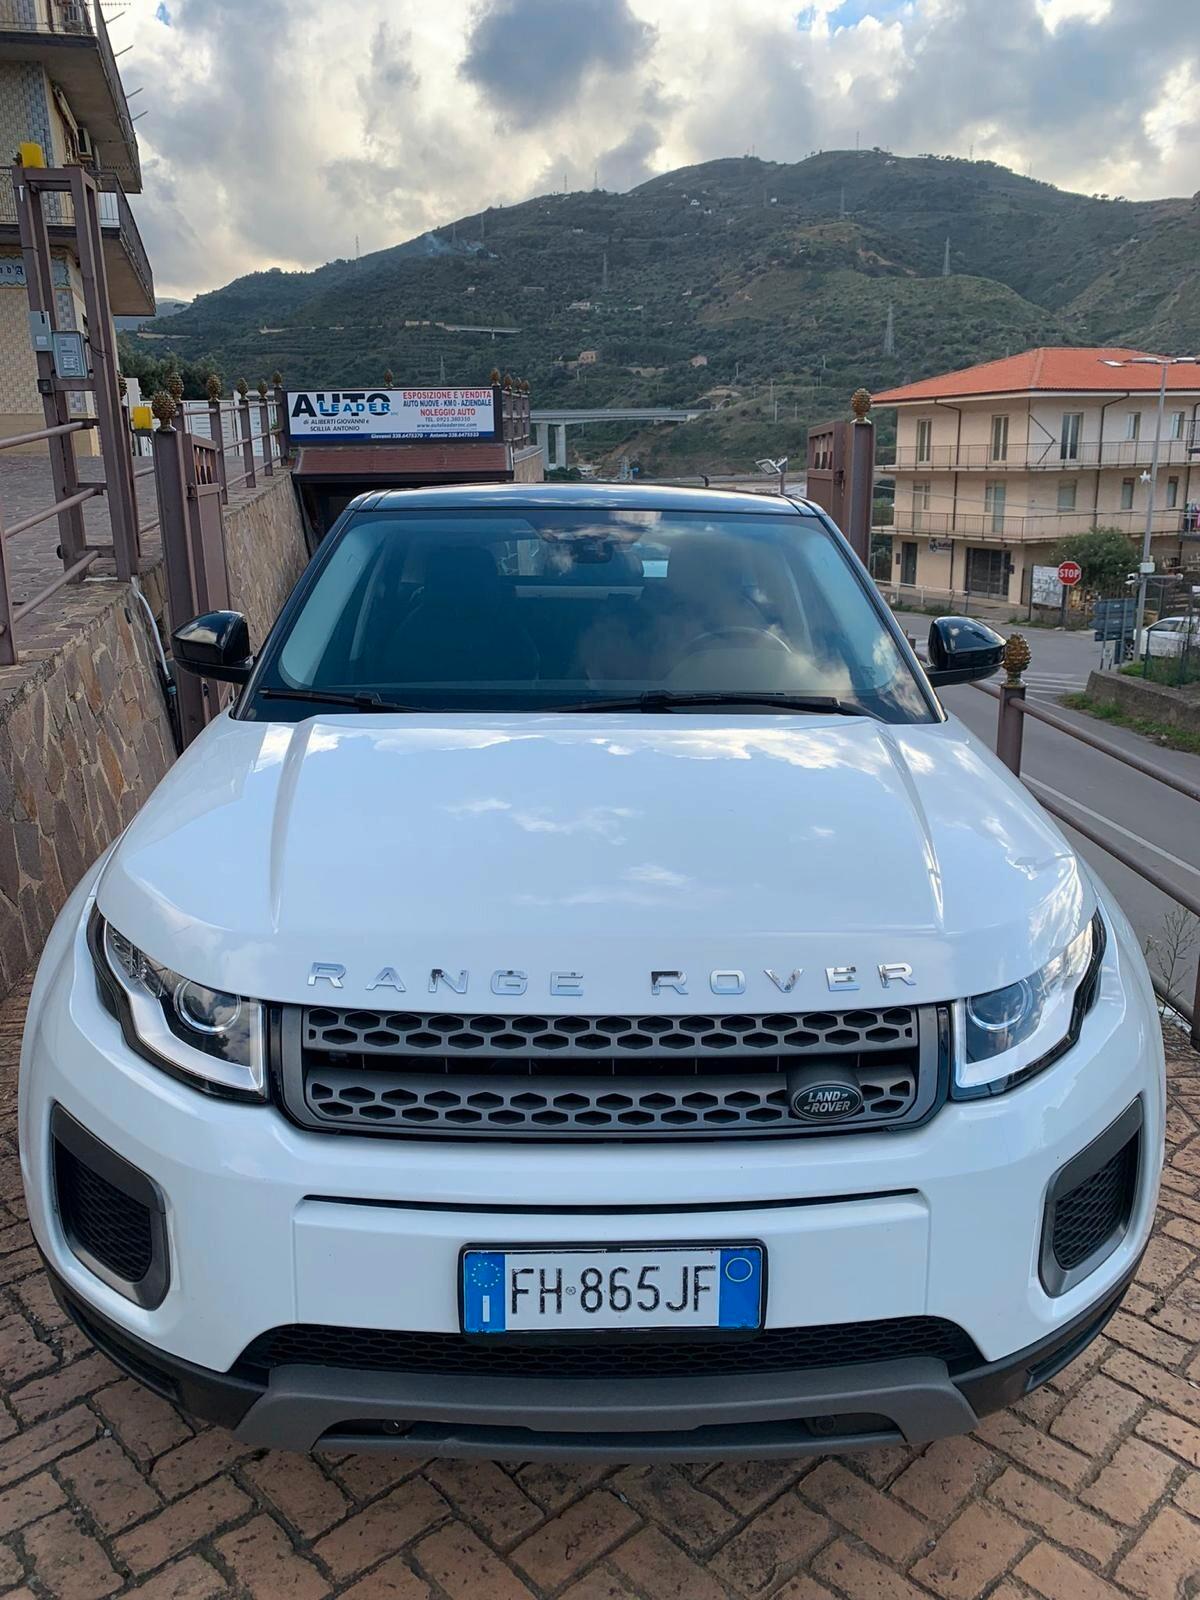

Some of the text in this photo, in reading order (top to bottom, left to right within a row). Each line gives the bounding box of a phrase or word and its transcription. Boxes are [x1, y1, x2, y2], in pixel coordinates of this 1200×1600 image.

[403, 390, 491, 400] ESPOSIZIONE E VENDITA
[291, 393, 391, 417] AUTO
[319, 401, 391, 412] LEADER
[461, 399, 491, 407] AZIENDALE
[420, 408, 476, 416] NOLEGGIO AUTO
[1059, 568, 1080, 578] STOP
[307, 961, 917, 996] RANGE ROVER
[808, 1091, 841, 1103] LAND
[810, 1101, 851, 1113] ROVER
